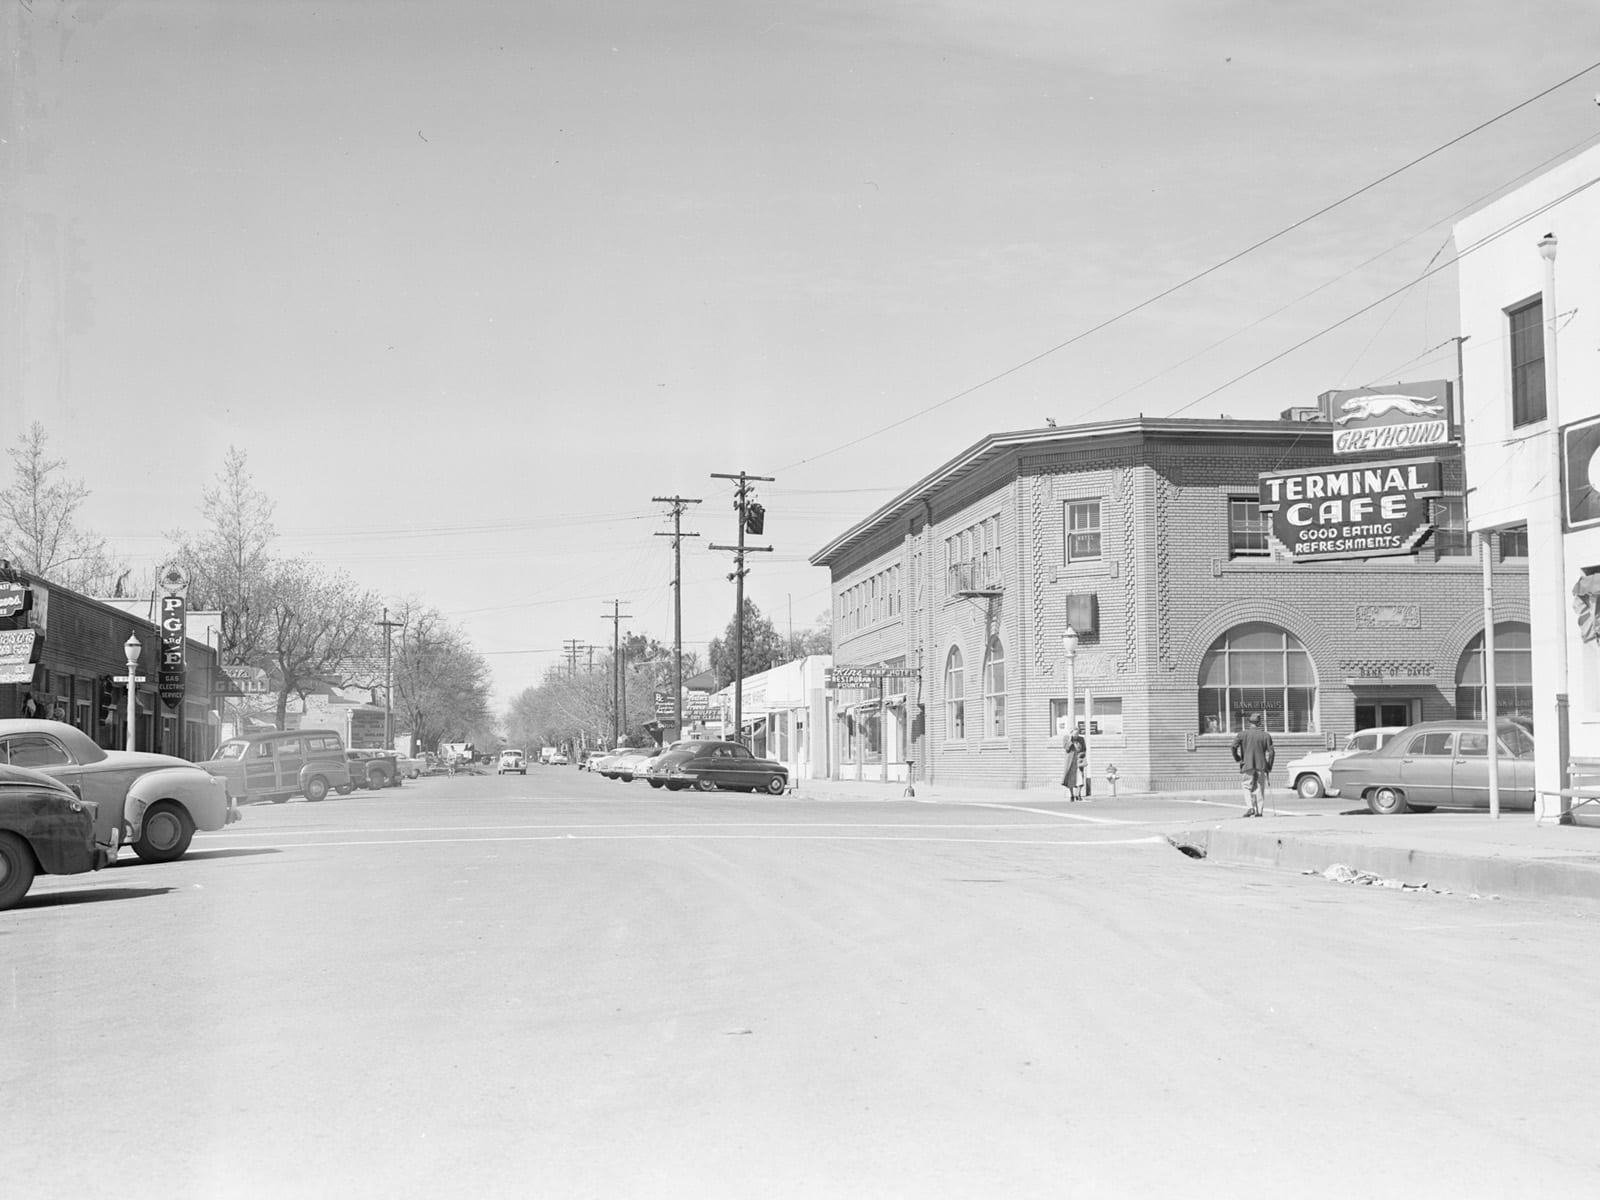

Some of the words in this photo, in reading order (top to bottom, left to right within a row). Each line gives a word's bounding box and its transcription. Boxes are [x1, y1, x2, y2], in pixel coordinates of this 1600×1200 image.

[1336, 421, 1445, 451] GREYHOUND
[1265, 465, 1429, 503] TERMINAL
[1285, 494, 1408, 527] CAFE
[1298, 527, 1338, 541] GOOD
[1341, 522, 1393, 538] EATING
[1294, 535, 1401, 554] REFRESHMENTS
[164, 674, 181, 682] GAS
[1360, 667, 1383, 678] BANK
[1407, 667, 1432, 678] DAVIS
[159, 683, 185, 691] ELECTRIC
[215, 680, 267, 692] GRILL
[161, 691, 184, 699] SERVICE
